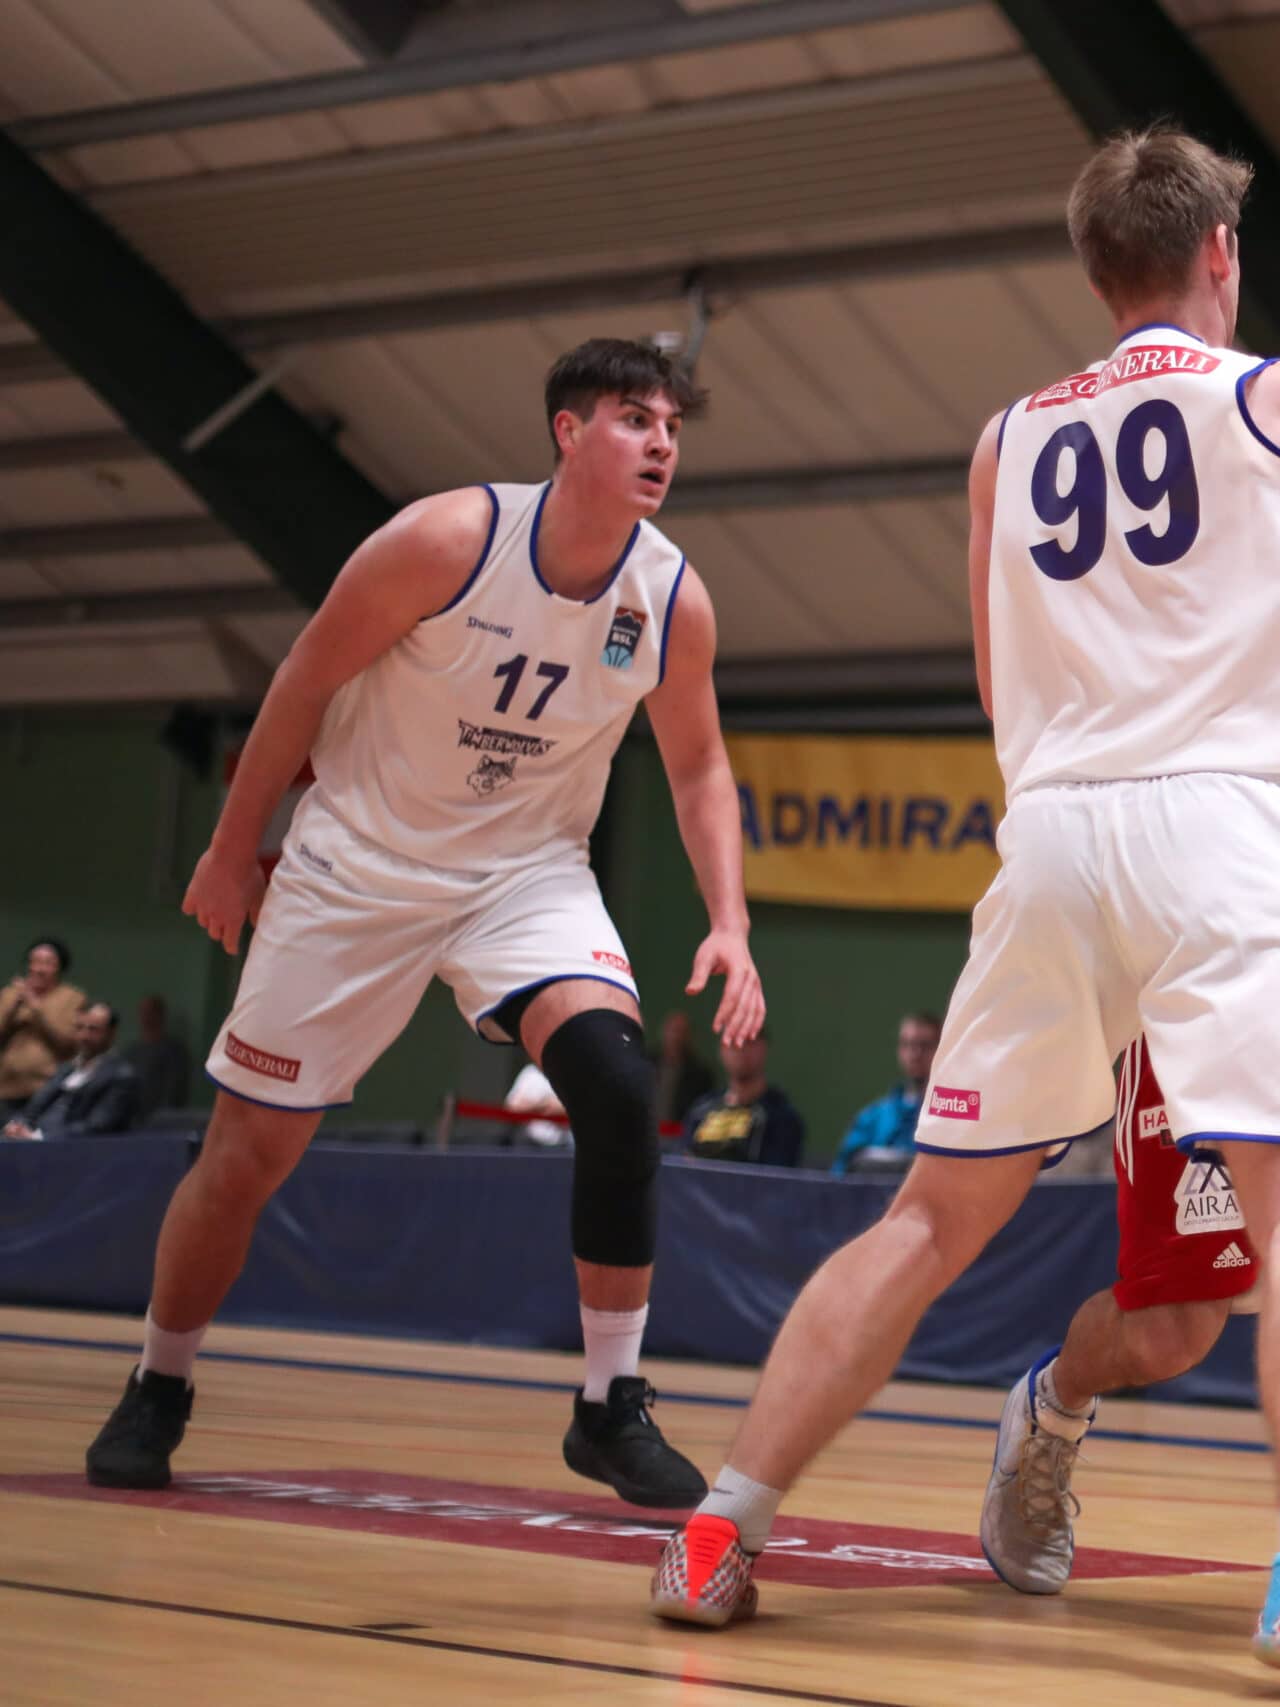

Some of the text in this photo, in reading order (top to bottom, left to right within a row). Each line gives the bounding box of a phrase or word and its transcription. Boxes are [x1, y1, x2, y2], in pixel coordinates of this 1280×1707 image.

[1029, 399, 1200, 581] 99
[493, 653, 569, 721] 17
[1184, 1193, 1239, 1219] AIRA
[1212, 1256, 1251, 1269] adidas
